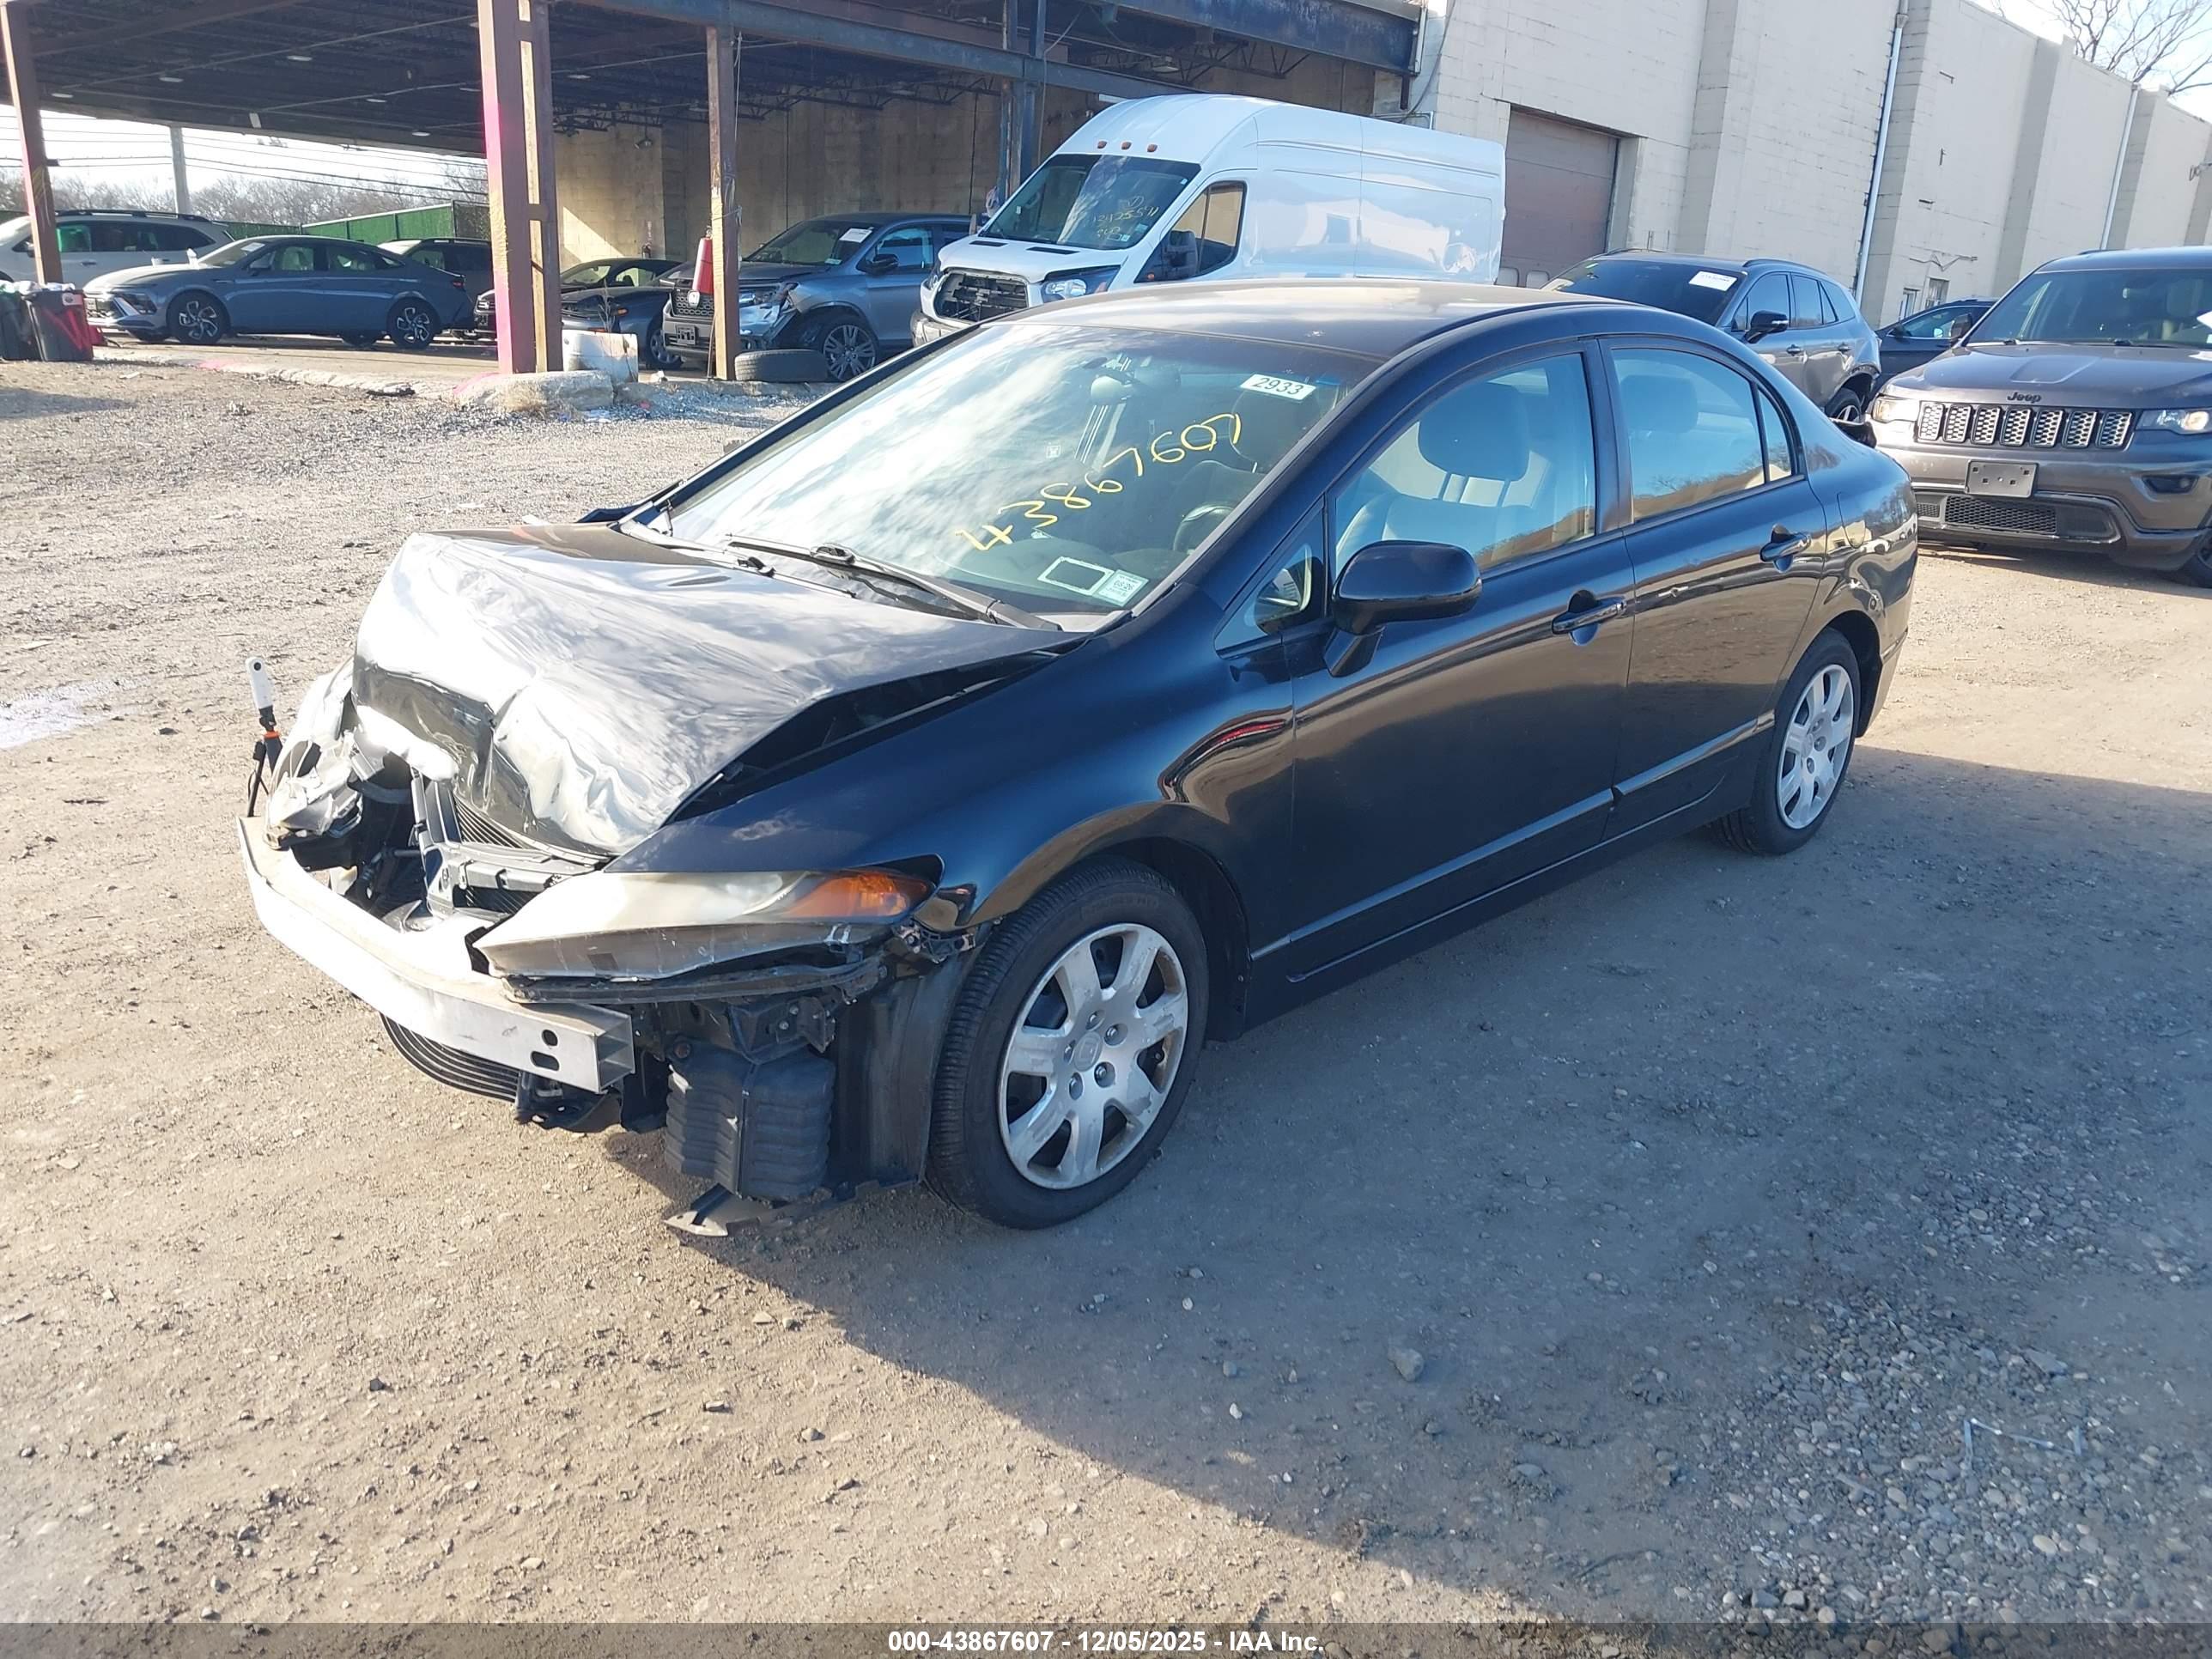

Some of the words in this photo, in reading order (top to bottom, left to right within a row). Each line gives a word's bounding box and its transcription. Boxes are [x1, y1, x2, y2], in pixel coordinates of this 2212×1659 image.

[1252, 377, 1304, 395] 2933
[2007, 392, 2042, 404] Jeep
[955, 413, 1242, 550] 43867607
